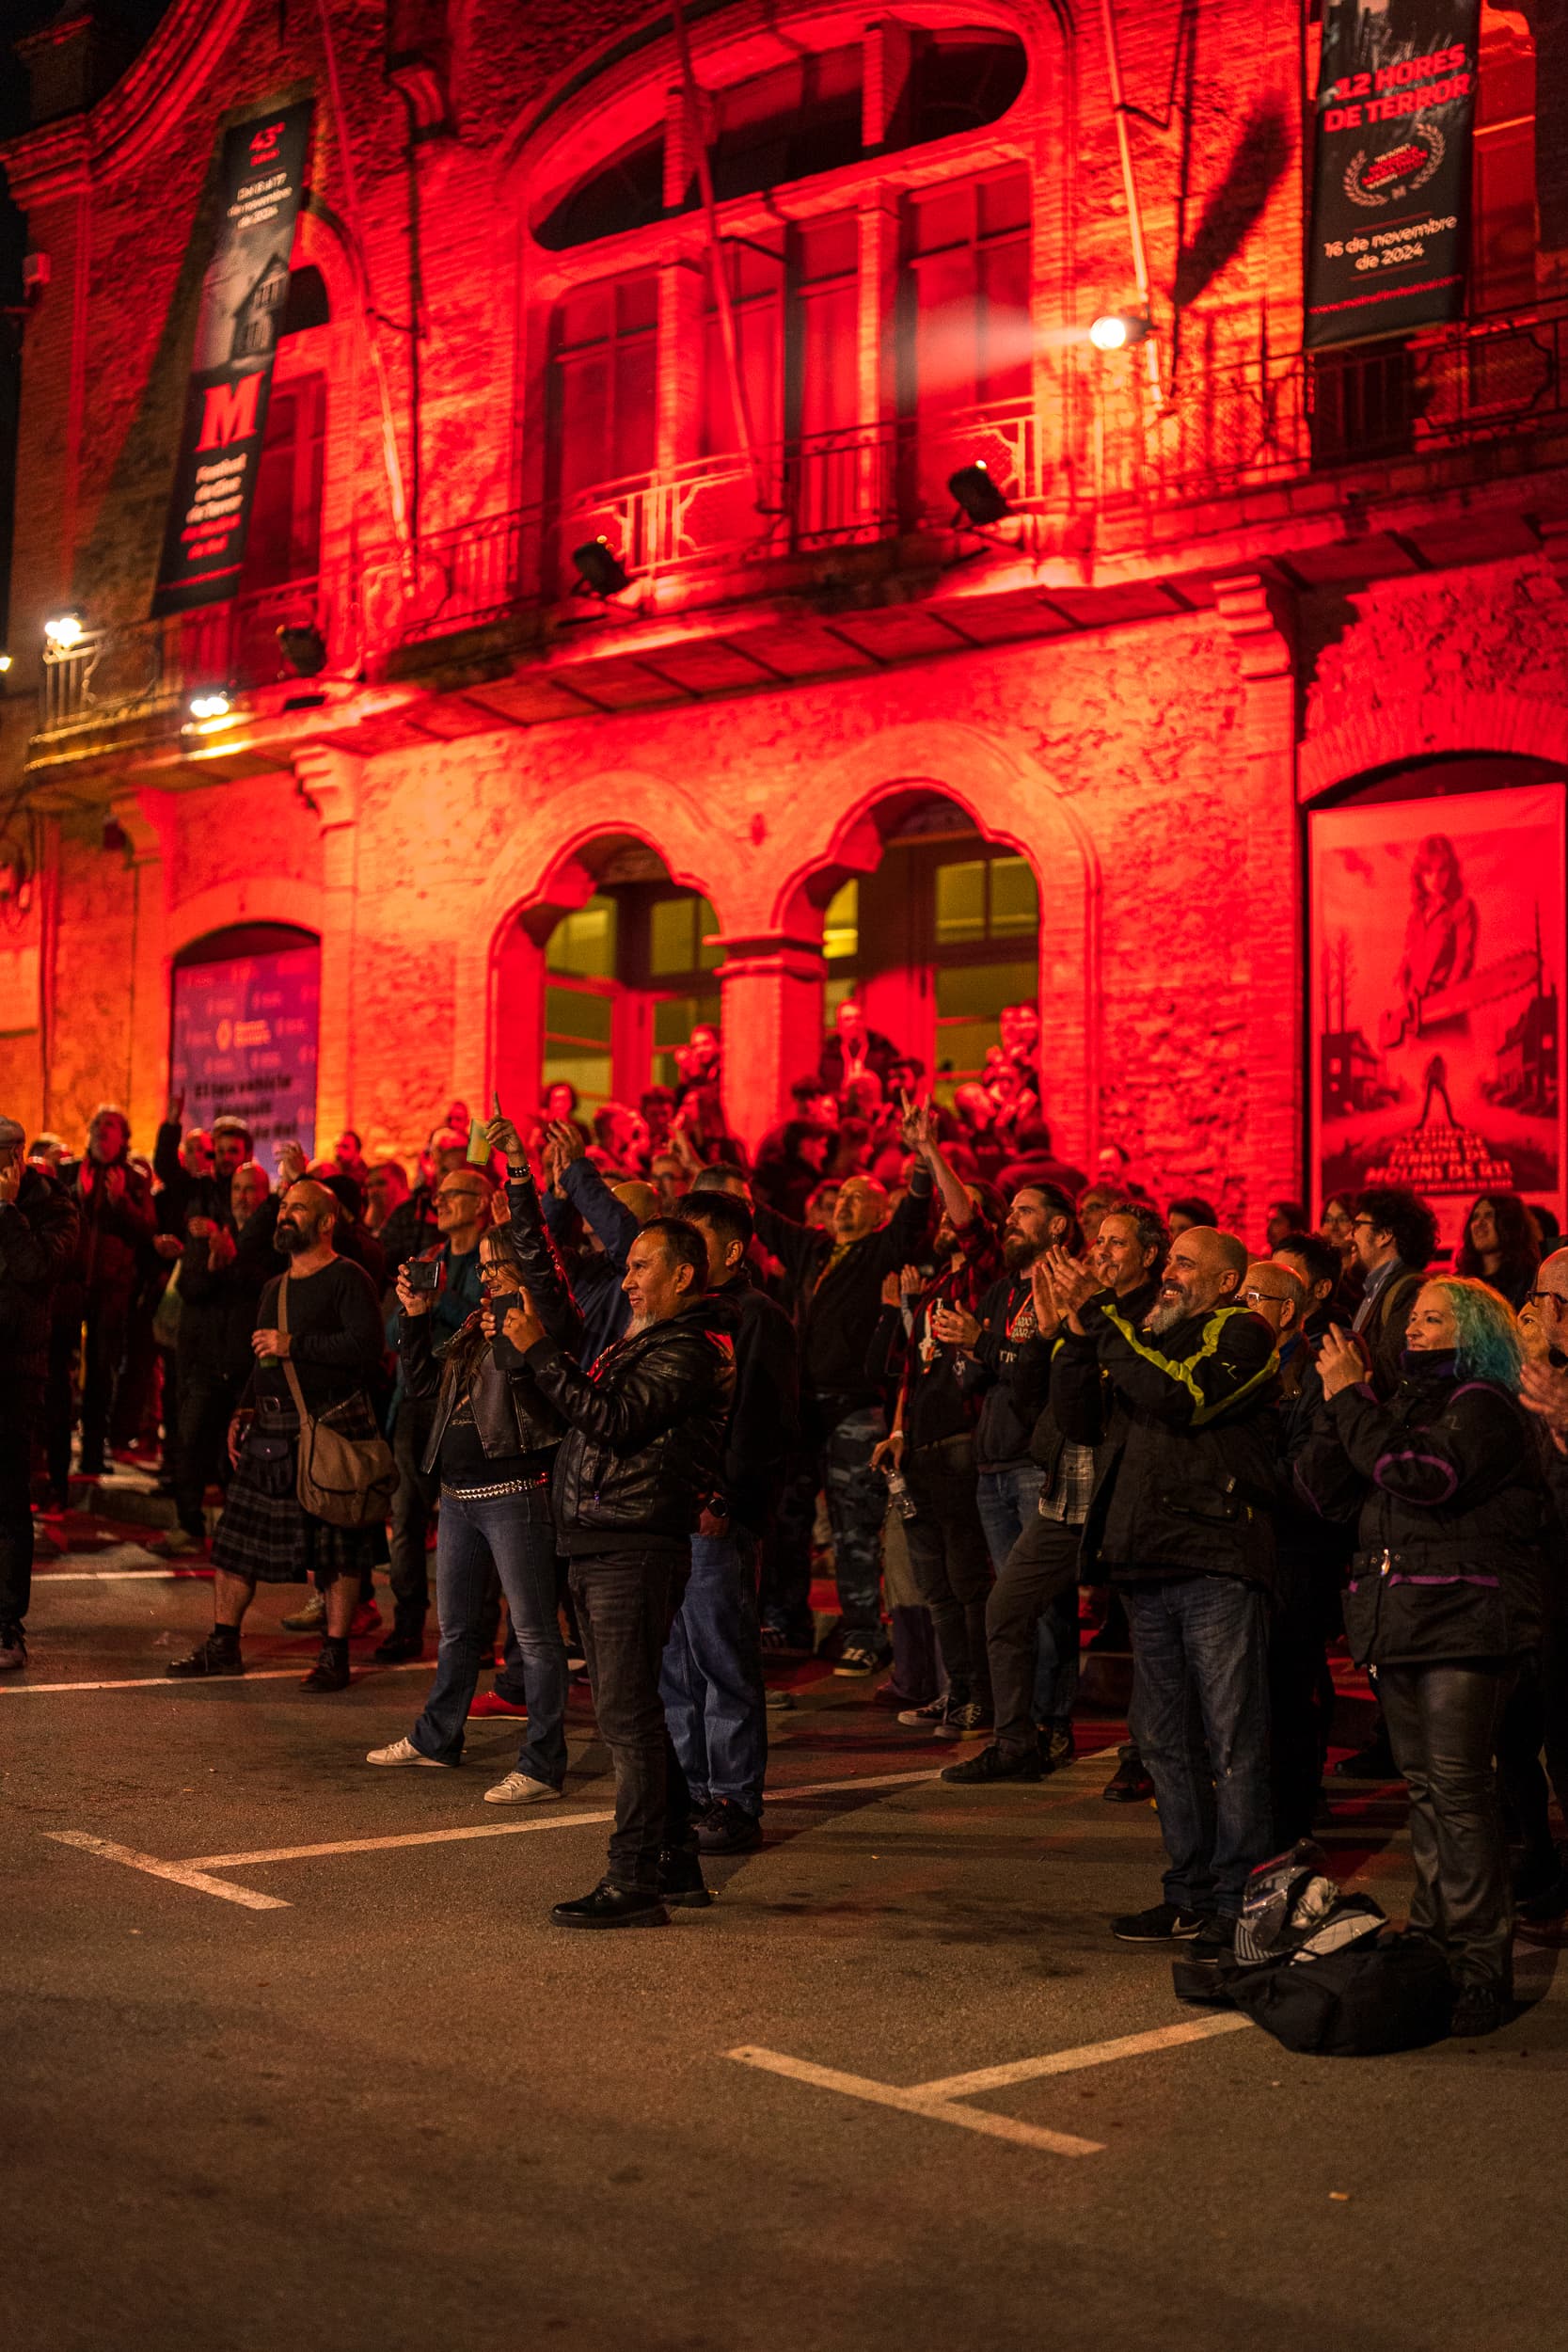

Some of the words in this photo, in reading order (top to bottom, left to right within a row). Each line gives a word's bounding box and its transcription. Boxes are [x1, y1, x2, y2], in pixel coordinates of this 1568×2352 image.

[1334, 72, 1371, 101] 12
[1374, 43, 1466, 91] HORES
[1324, 104, 1363, 133] DE
[1365, 73, 1470, 123] TERROR
[1323, 240, 1344, 258] 16
[1345, 236, 1370, 254] de
[1371, 215, 1457, 248] novembre
[1354, 253, 1379, 271] de
[1381, 241, 1425, 265] 2024
[195, 370, 266, 453] M
[1365, 1164, 1444, 1184] MOLINS
[1448, 1161, 1476, 1180] DE
